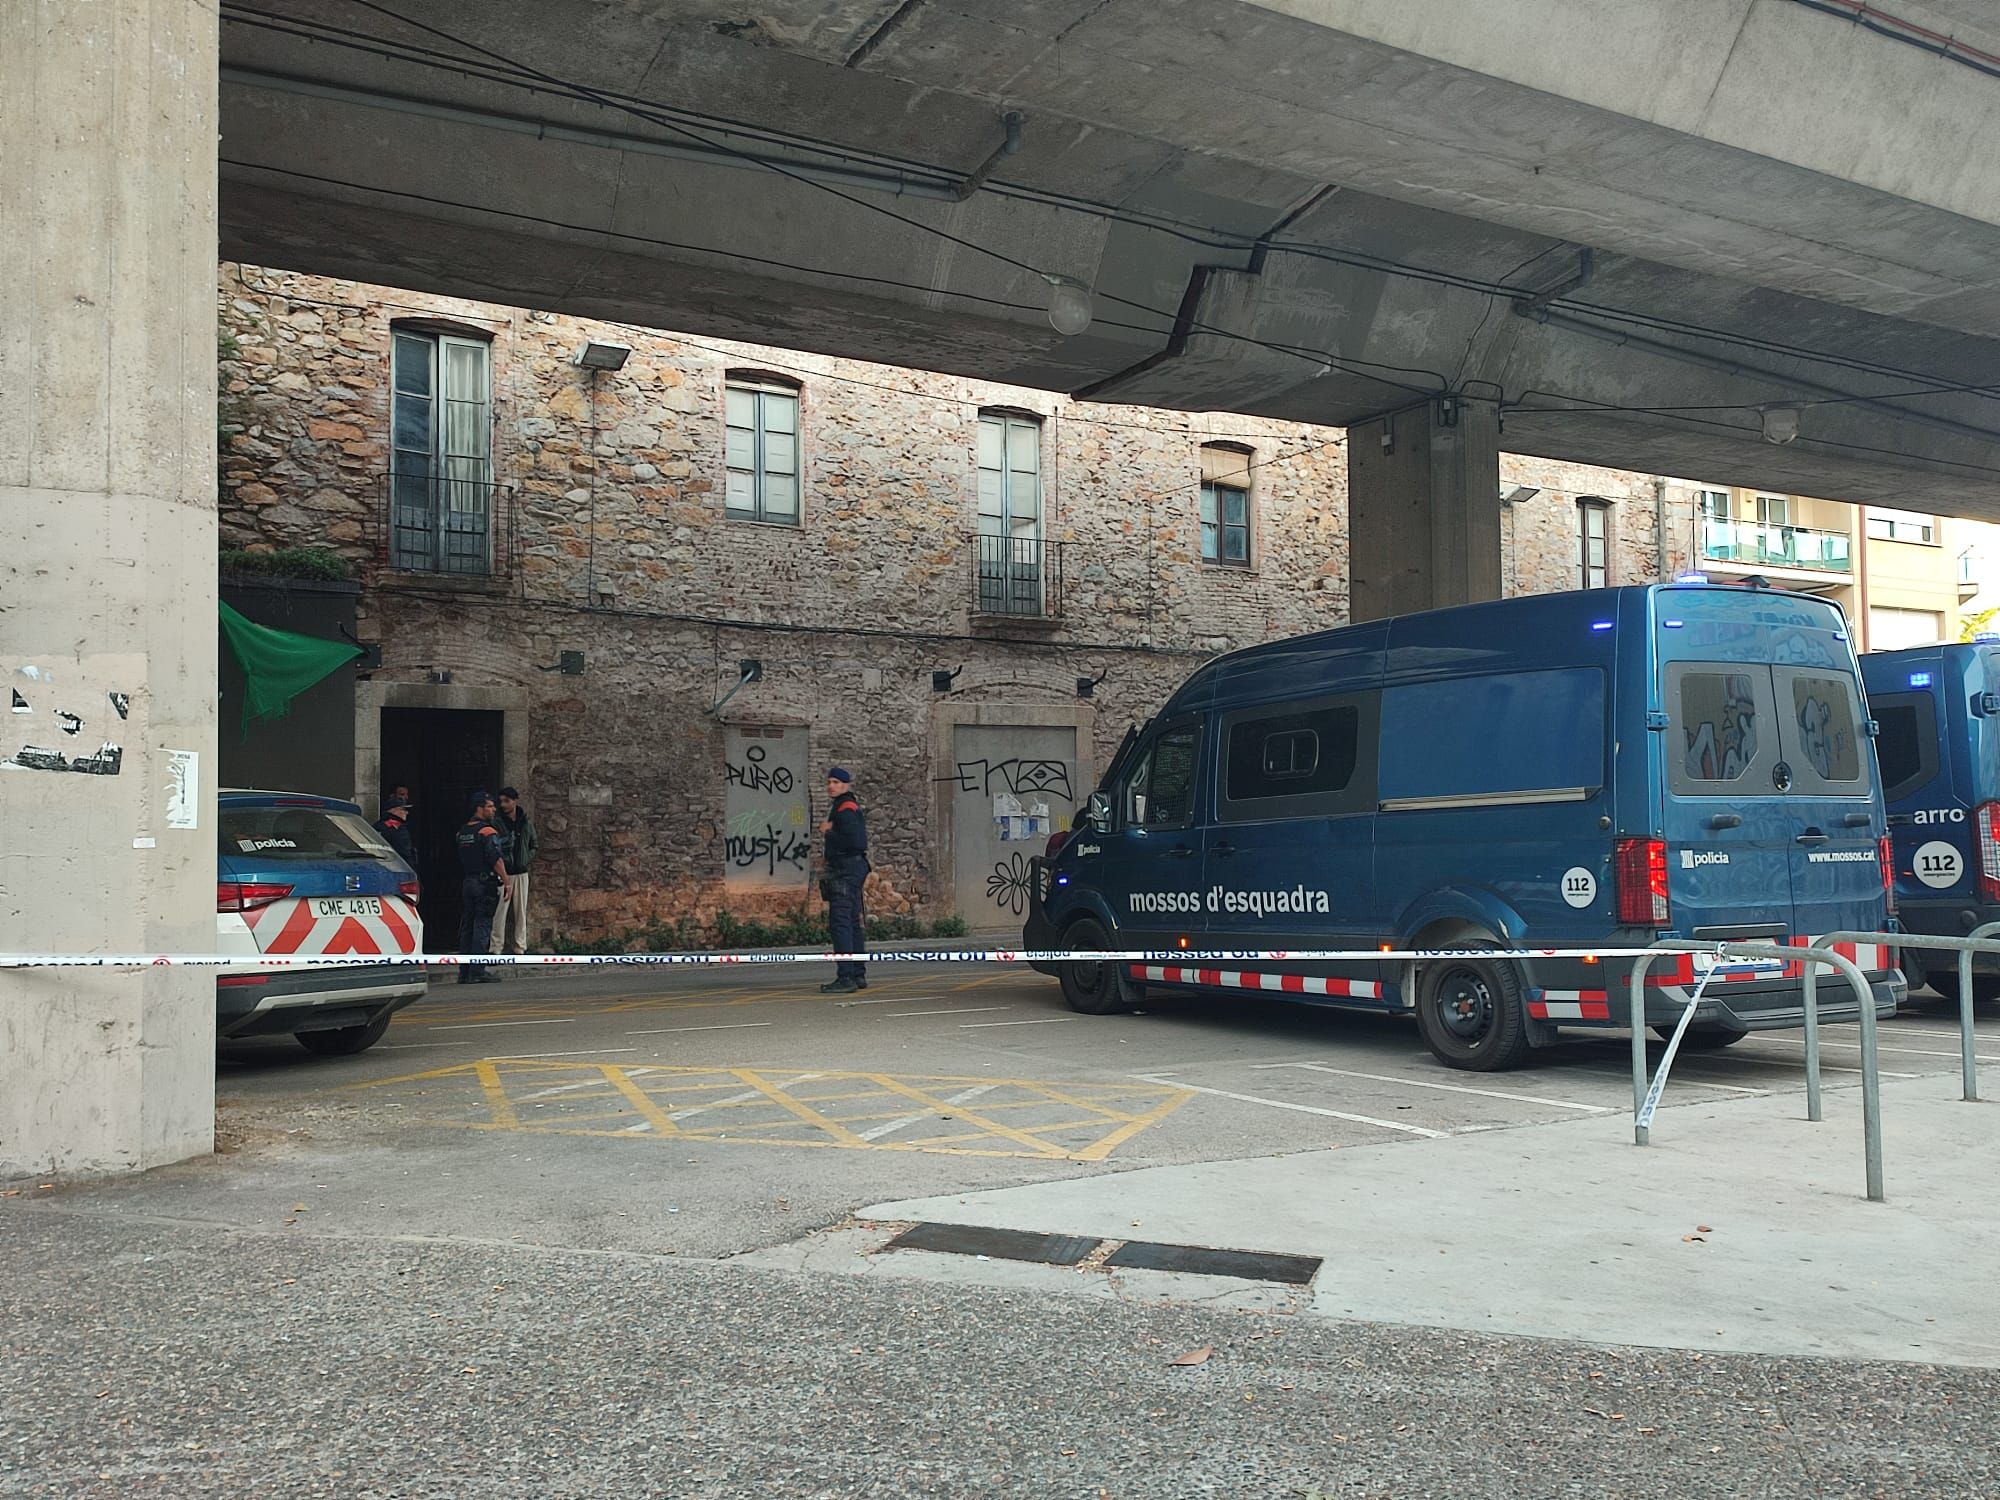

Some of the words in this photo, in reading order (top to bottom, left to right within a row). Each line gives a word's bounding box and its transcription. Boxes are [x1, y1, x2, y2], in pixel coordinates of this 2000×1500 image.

[1913, 808, 1965, 825] arro
[255, 839, 296, 850] policia
[1693, 852, 1730, 866] policia
[1807, 850, 1876, 863] www.mossos.cat
[1922, 855, 1956, 872] 112
[1567, 878, 1590, 892] 112
[319, 902, 345, 916] CME
[350, 900, 381, 915] 4815
[1129, 892, 1200, 913] mossos
[1206, 884, 1330, 918] d'esquadra
[1026, 950, 1071, 960] policia
